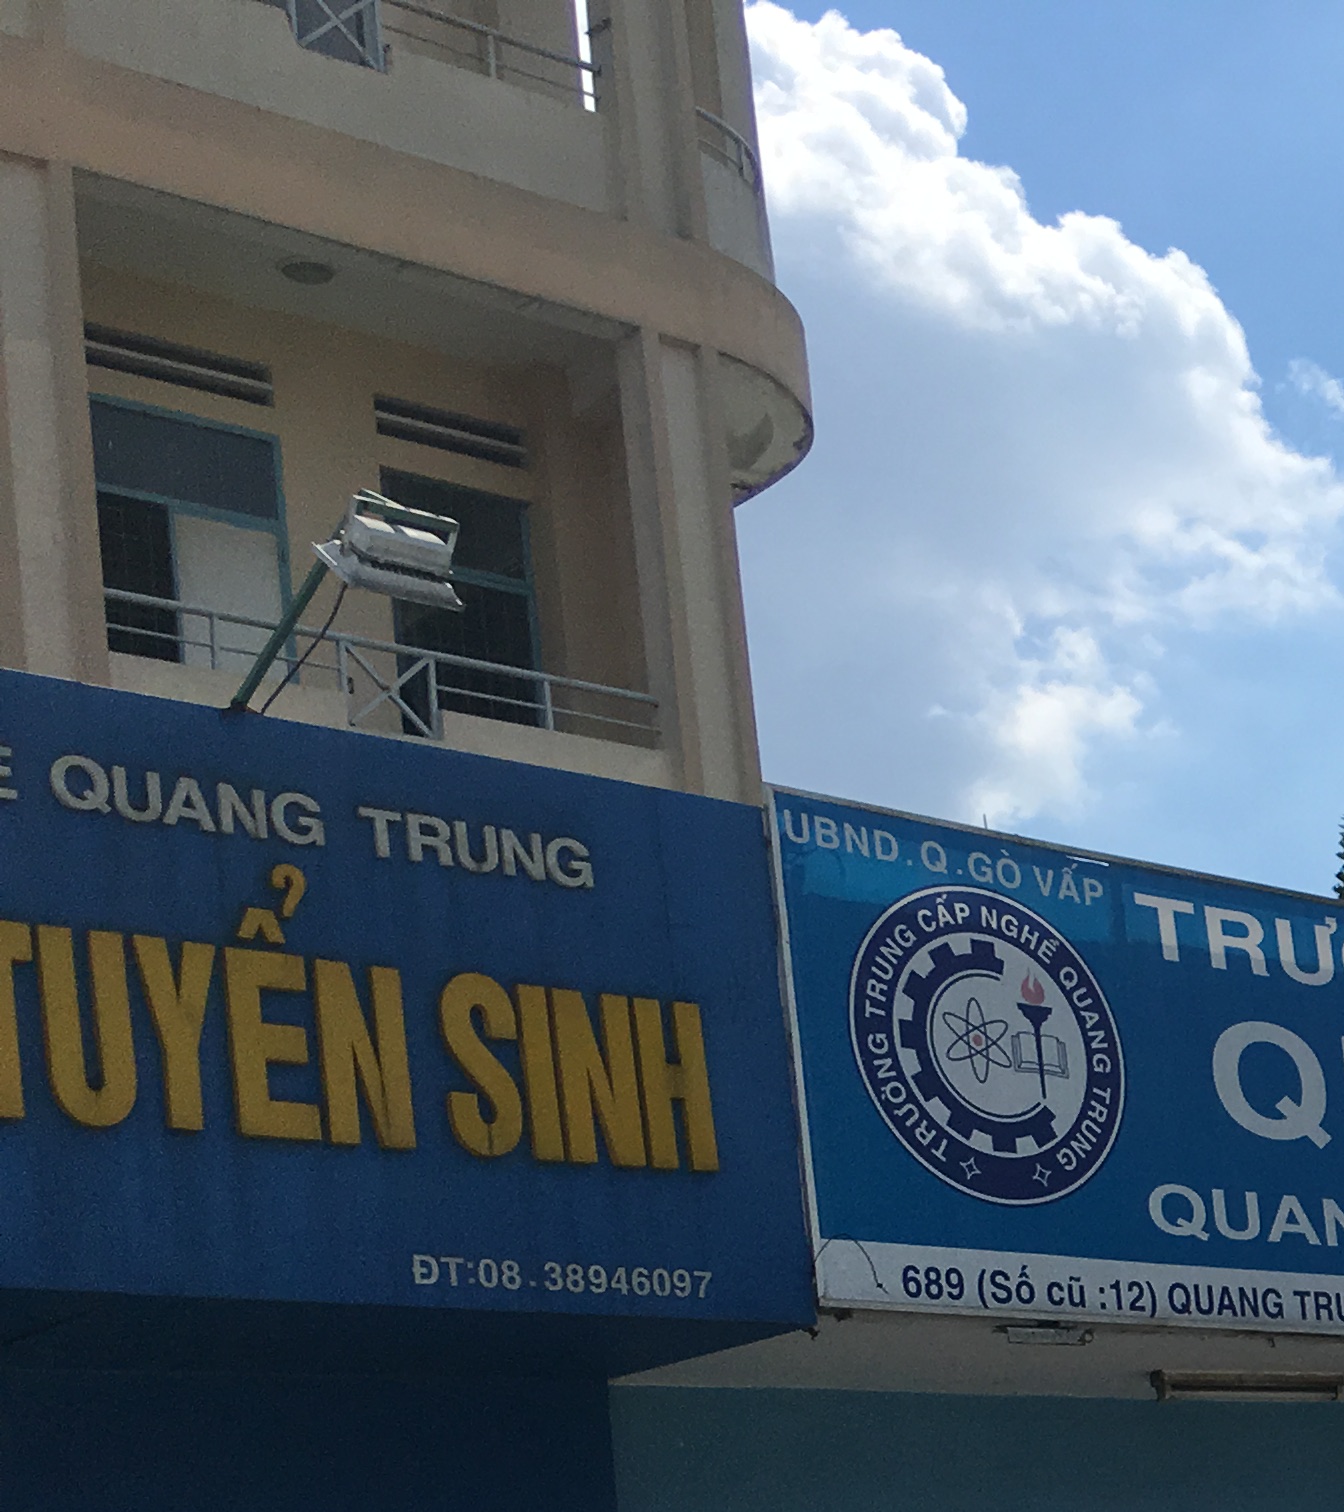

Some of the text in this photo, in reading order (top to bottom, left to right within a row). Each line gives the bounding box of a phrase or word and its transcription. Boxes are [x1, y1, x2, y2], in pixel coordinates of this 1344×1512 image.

[51, 755, 325, 846] QUANG
[358, 806, 594, 888] TRUNG
[917, 895, 970, 932] CẤP
[1034, 863, 1103, 905] VẤP
[866, 924, 917, 1018] TRUNG
[1060, 967, 1111, 1074] QUANG
[439, 972, 719, 1172] SINH
[1057, 1087, 1111, 1171] TRUNG
[902, 1265, 964, 1300] 689
[978, 1265, 1035, 1308] (Số
[1047, 1278, 1085, 1308] cũ
[1168, 1283, 1284, 1320] QUANG
